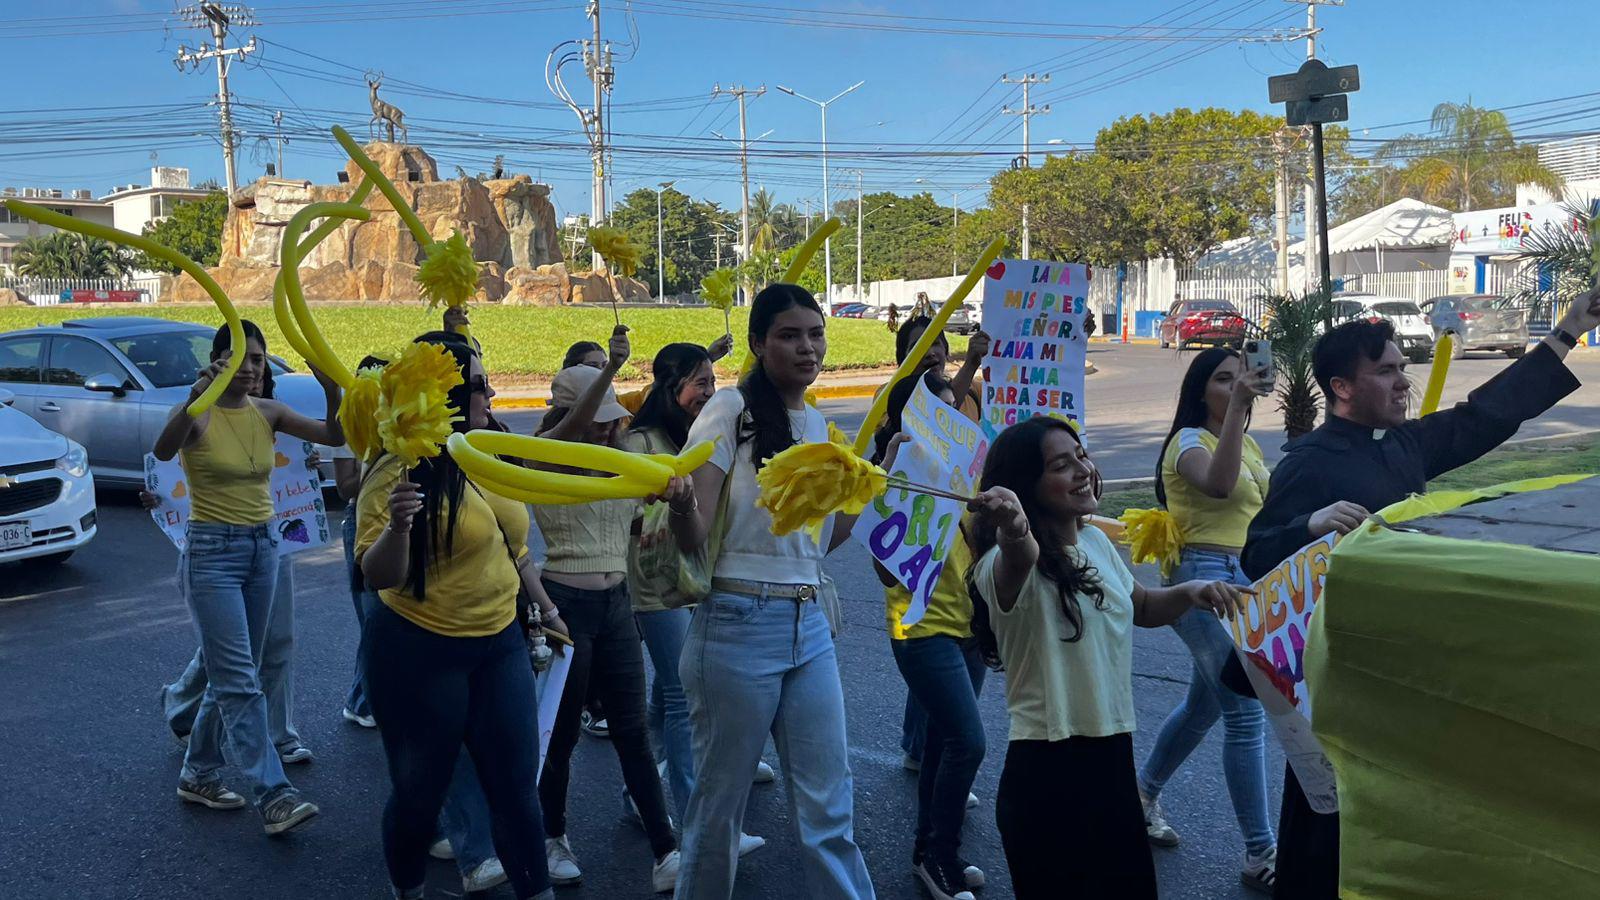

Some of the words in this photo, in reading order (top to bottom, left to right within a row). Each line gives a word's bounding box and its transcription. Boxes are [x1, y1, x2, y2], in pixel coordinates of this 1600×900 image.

[1031, 265, 1071, 286] LAVA
[1003, 289, 1037, 309] MIS
[1041, 293, 1084, 315] PIES
[1013, 312, 1077, 341] SEÑOR,
[992, 340, 1033, 360] LAVA
[1040, 343, 1064, 362] MI
[1006, 364, 1059, 386] ALMA
[987, 386, 1030, 406] PARA
[1037, 389, 1075, 410] SER
[934, 406, 977, 454] QUE
